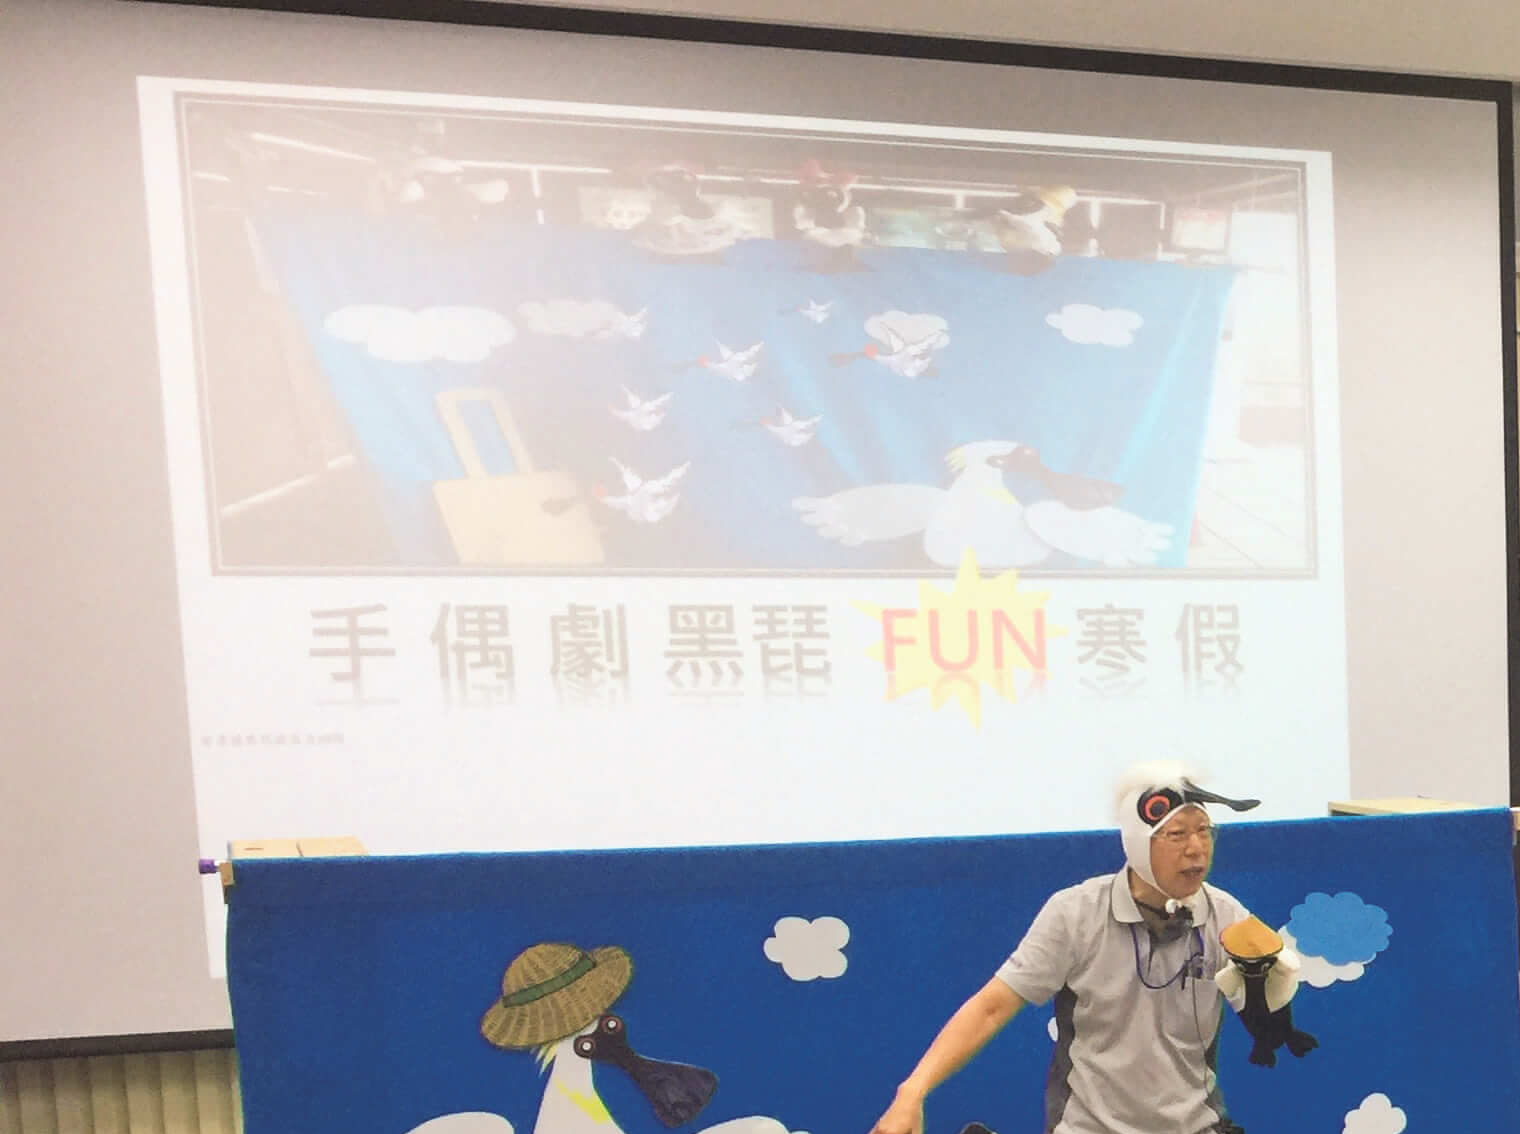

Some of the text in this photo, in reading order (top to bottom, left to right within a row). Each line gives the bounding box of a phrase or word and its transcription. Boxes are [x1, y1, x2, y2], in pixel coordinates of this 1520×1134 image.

[308, 602, 1244, 685] 手偶劇黑琵 FUN 寒假
